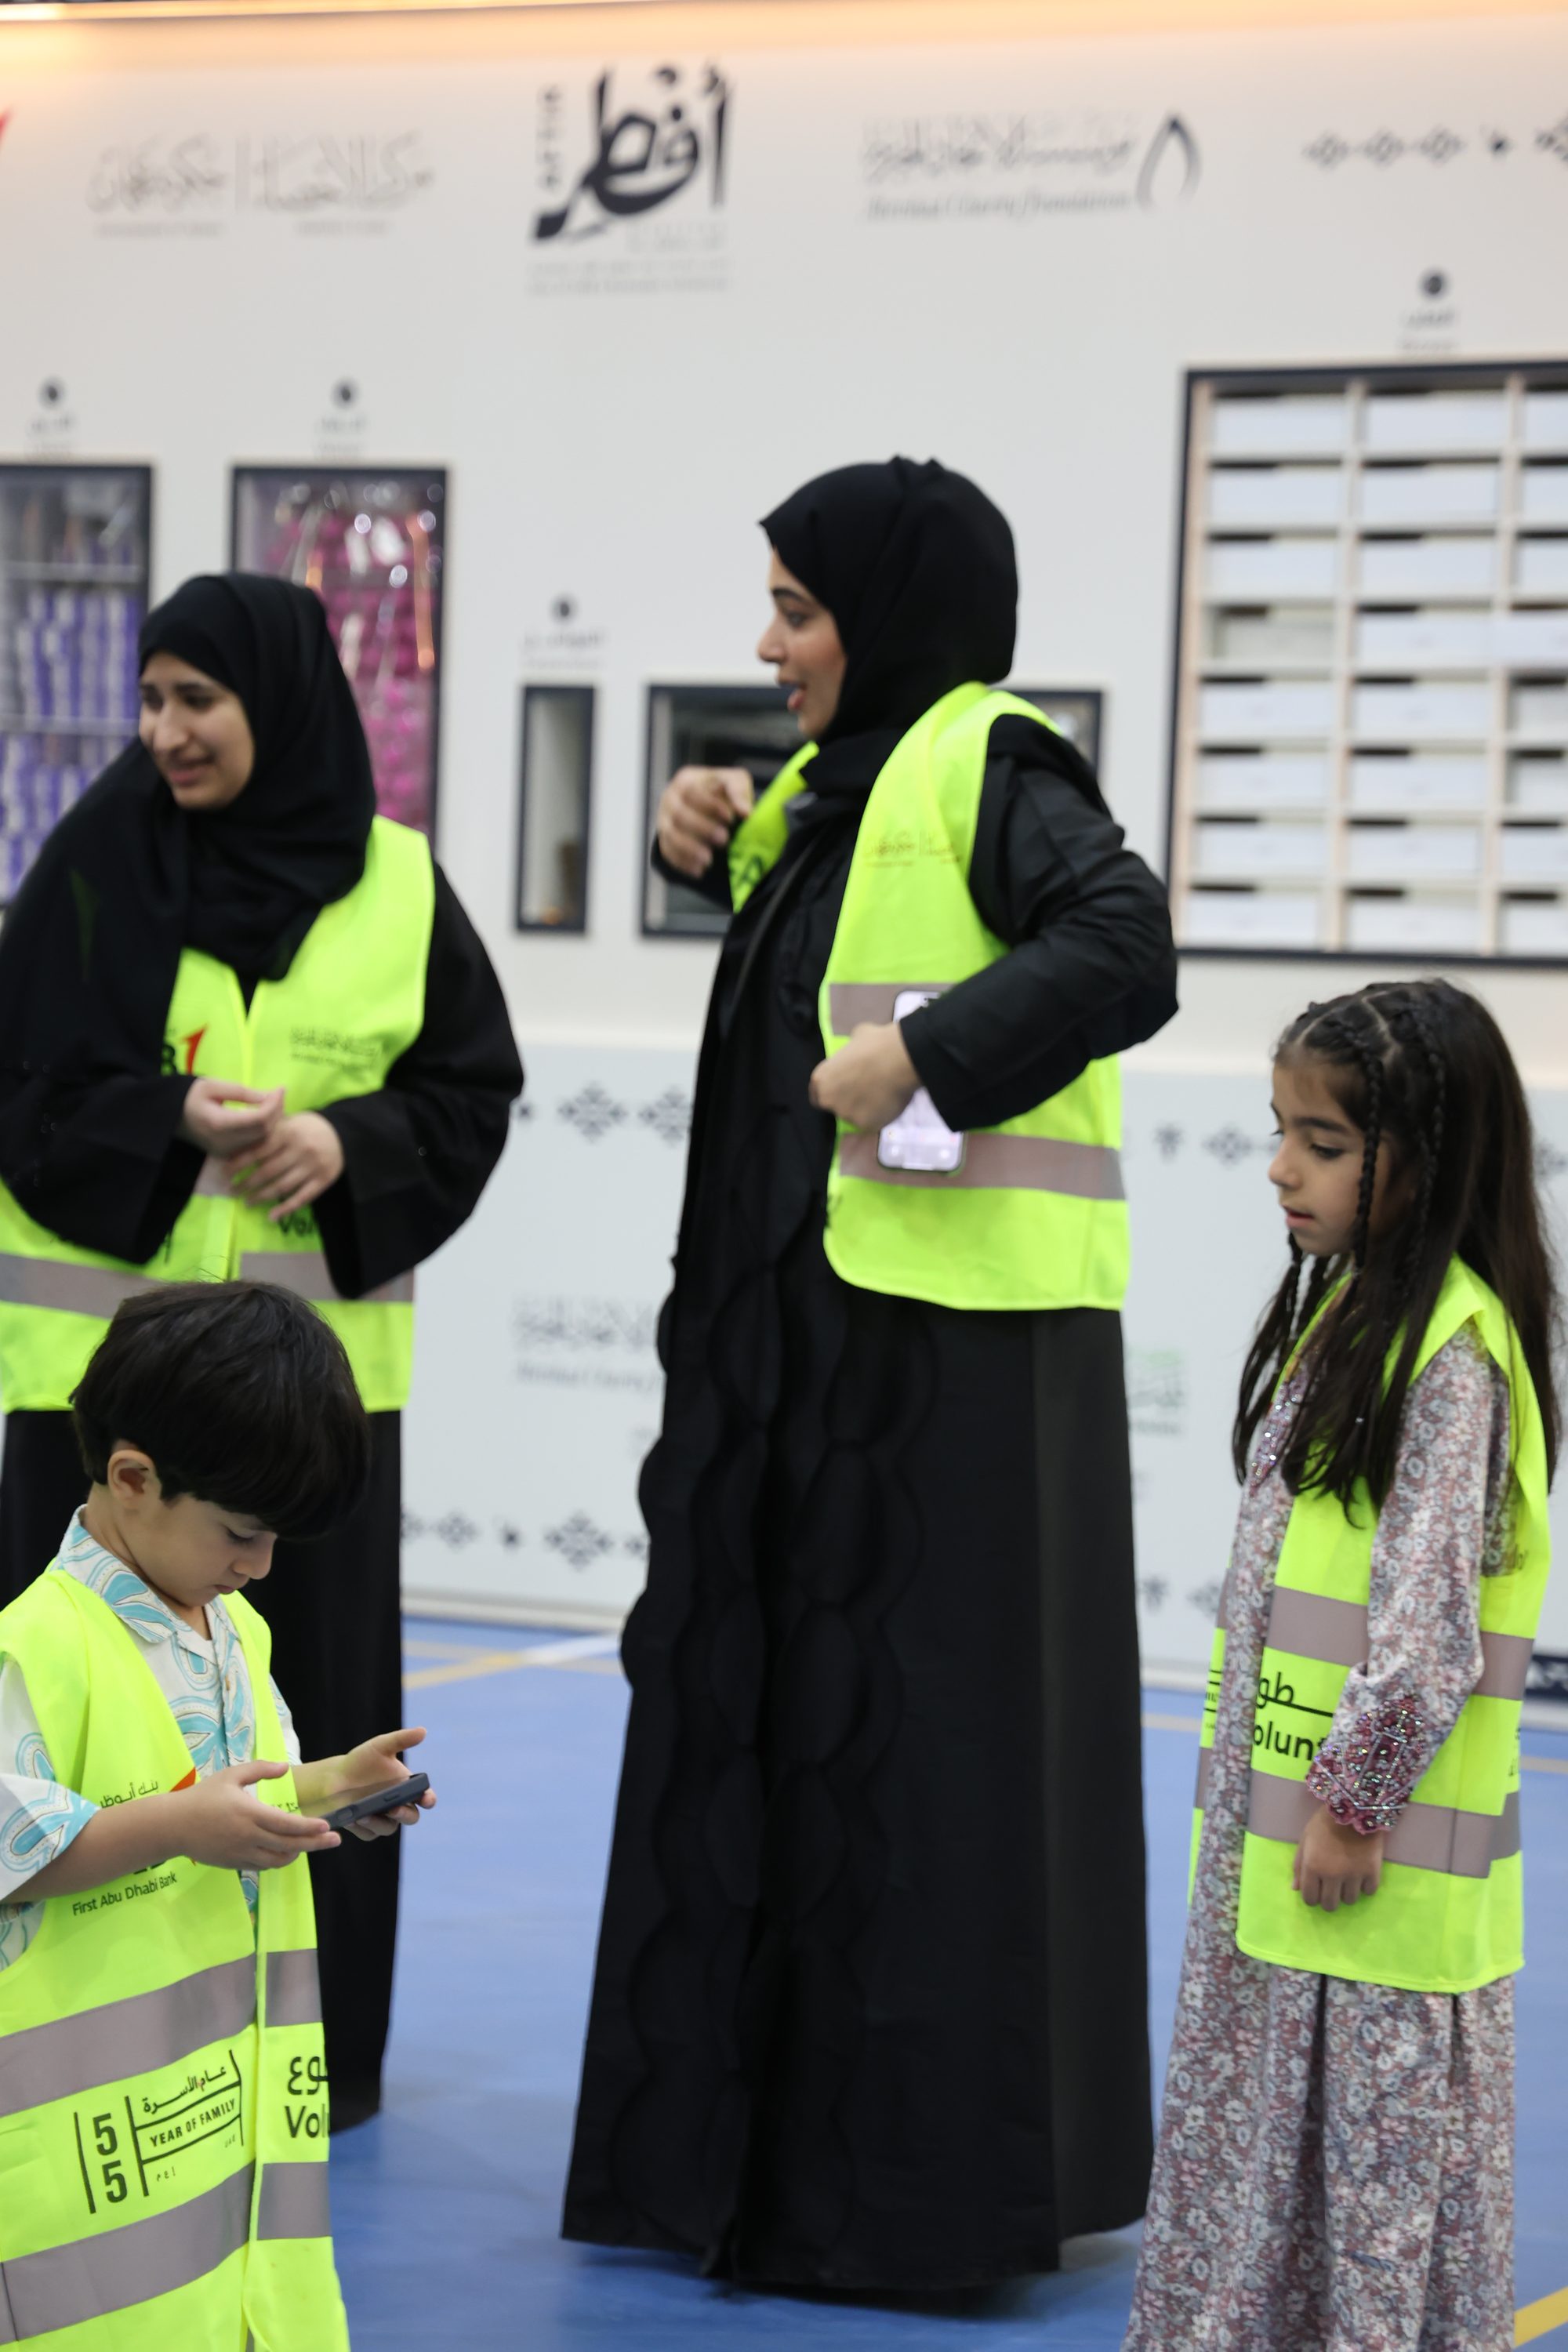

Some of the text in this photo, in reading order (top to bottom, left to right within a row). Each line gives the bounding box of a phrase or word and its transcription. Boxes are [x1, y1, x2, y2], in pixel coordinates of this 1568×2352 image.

[1254, 1721, 1327, 1762] olun
[72, 1871, 177, 1916] First Abu Dhabi Bank
[149, 2098, 235, 2147] YEAR OF FAMILY
[285, 2103, 329, 2139] Vol
